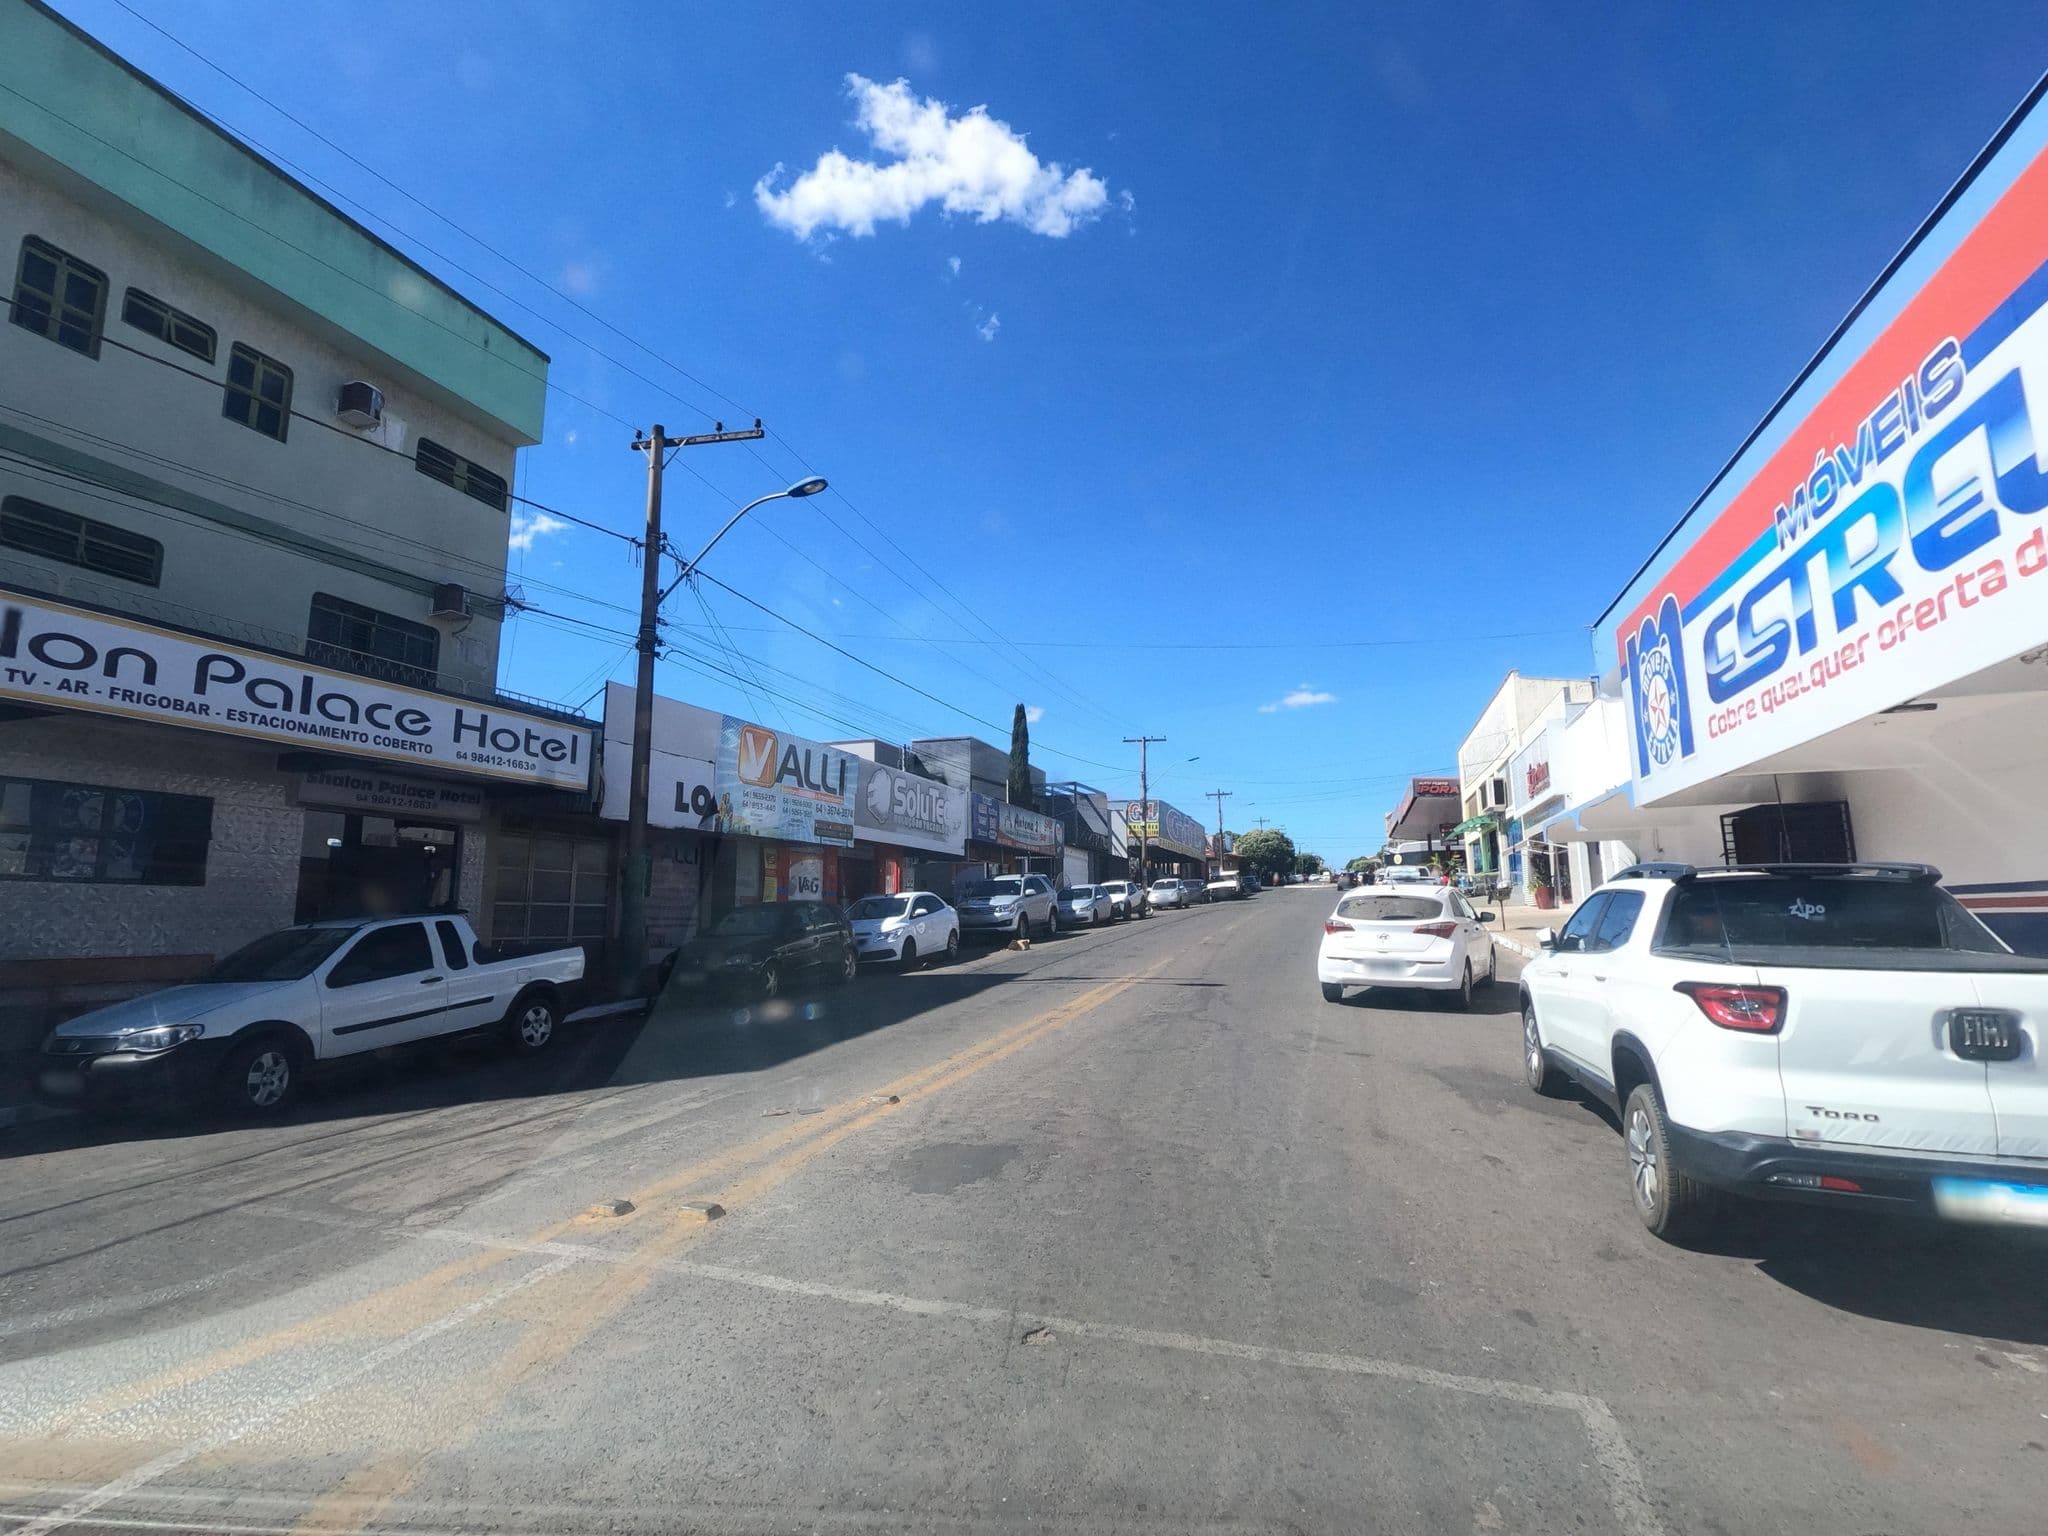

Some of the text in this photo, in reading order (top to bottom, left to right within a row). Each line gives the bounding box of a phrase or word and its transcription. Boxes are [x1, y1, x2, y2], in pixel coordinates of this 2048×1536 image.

[1775, 337, 1966, 552] MÓVEIS
[1708, 527, 2048, 739] Cobre qualquer oferta d
[5, 668, 433, 754] TV AR FRIGOBAR ESTACIONAMENTO COBERTO
[194, 654, 432, 736] Palace
[453, 708, 578, 764] Hotel
[456, 751, 530, 771] 64 98412-1663
